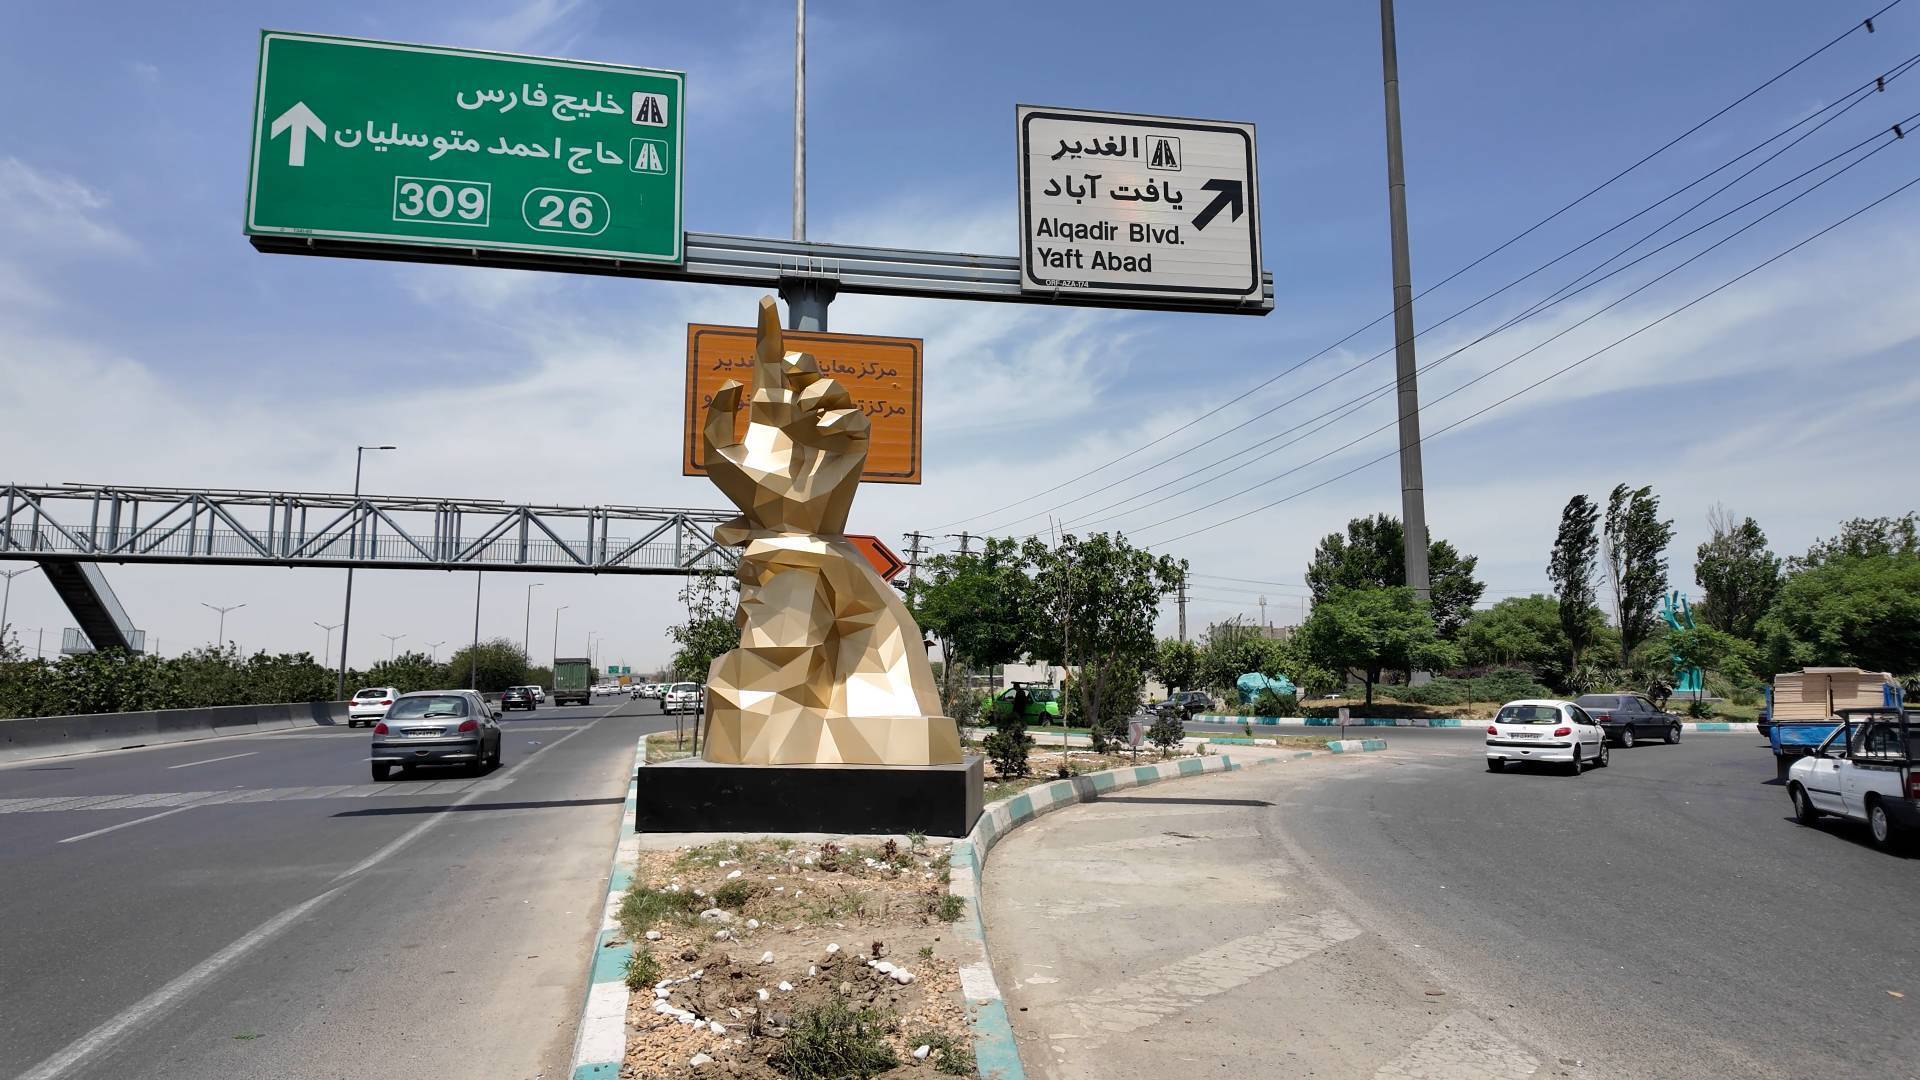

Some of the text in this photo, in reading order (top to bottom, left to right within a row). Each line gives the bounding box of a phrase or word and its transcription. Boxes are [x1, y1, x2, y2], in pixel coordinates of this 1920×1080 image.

[456, 83, 625, 121] خلیج فارس
[334, 120, 624, 174] حاج احمد متوسلیان
[1050, 135, 1139, 161] الغدیر
[399, 182, 485, 220] 309
[1043, 173, 1183, 211] یافت آباد
[538, 195, 594, 230] 26
[1036, 217, 1185, 246] Alqadir Blvd.
[1037, 247, 1152, 273] Yaft Abad
[857, 362, 897, 380] مرکز
[865, 400, 906, 418] مرکز
